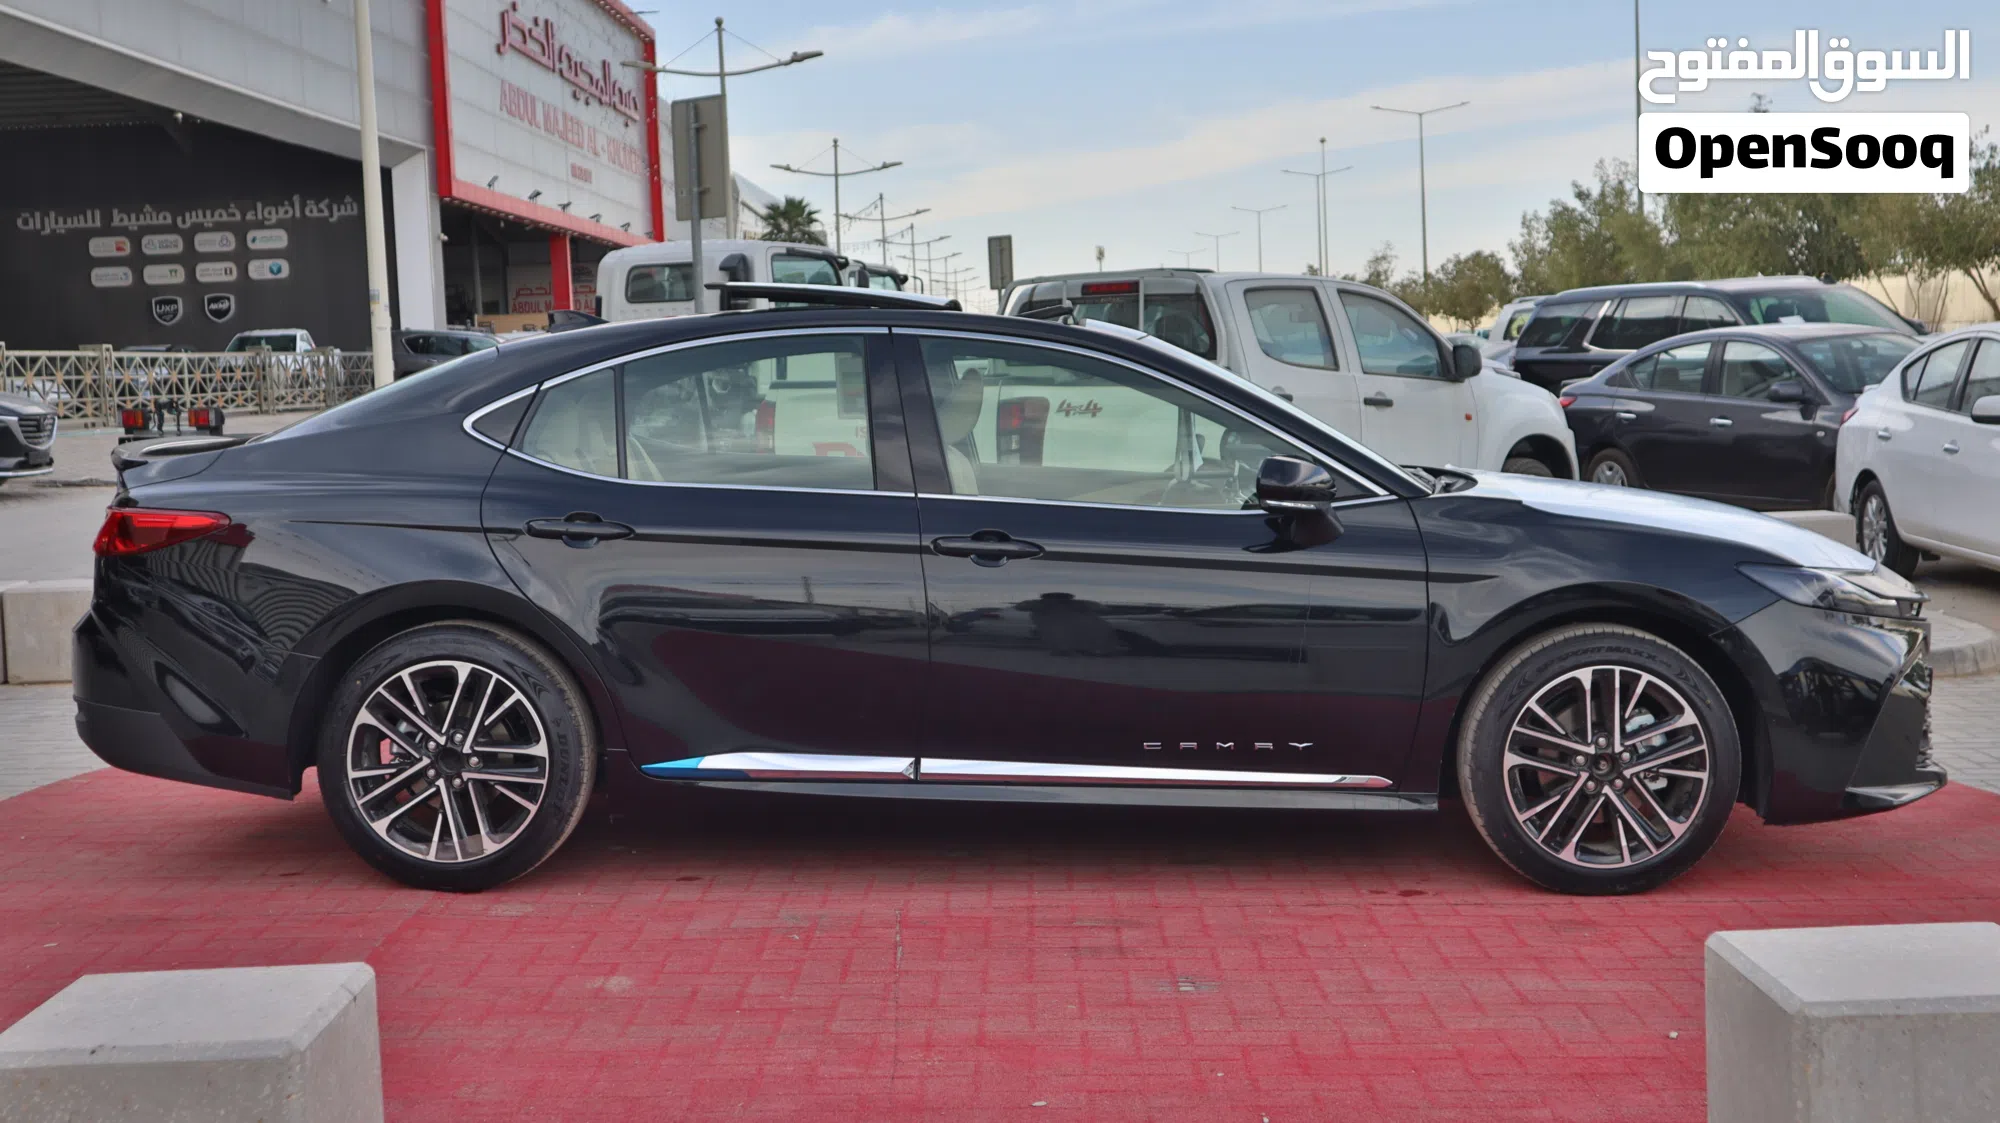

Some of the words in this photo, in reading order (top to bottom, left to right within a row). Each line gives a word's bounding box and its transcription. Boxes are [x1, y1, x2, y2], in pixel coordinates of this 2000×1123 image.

[496, 1, 557, 73] الخضر
[500, 79, 541, 130] ABDUL
[542, 101, 585, 150] MAJEED
[586, 125, 601, 158] AL
[16, 207, 102, 236] للسيارات
[111, 204, 173, 231] مشيط
[176, 203, 242, 230] خميس
[245, 194, 301, 226] أضواء
[304, 195, 358, 223] شركة
[512, 280, 553, 302] لخضر
[511, 300, 543, 313] ABDUL
[1055, 399, 1103, 418] 4x4
[1142, 741, 1314, 751] CAMRY
